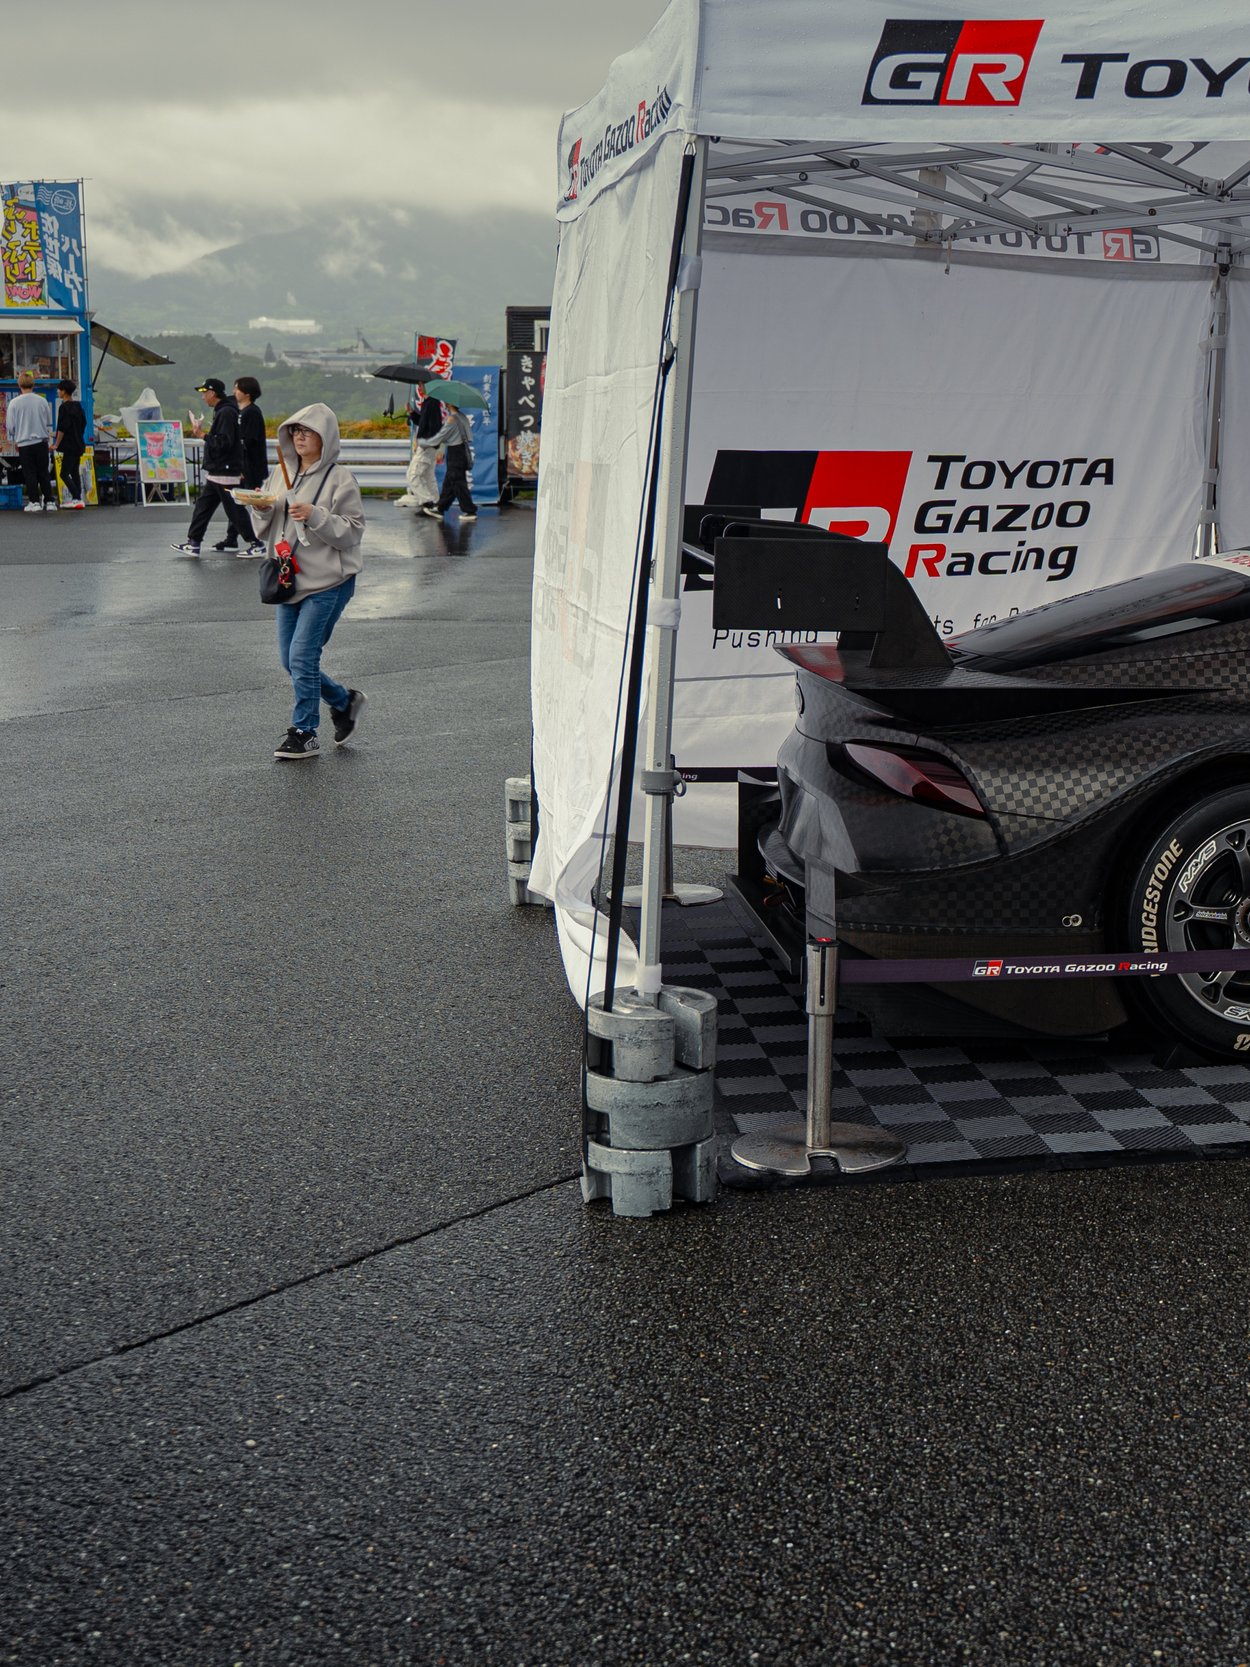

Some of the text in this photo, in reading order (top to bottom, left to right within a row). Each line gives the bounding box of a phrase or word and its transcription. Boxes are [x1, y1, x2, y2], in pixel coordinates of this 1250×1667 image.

[869, 52, 1025, 102] GR
[603, 115, 636, 162] GAZOO
[926, 455, 1114, 490] TOYOTA
[914, 500, 1091, 534] GAZOO
[904, 540, 1078, 581] Racing
[1178, 839, 1217, 893] RAYS
[1141, 838, 1184, 954] RIDGESTONE
[1004, 965, 1060, 974] TOYOTA
[1064, 963, 1116, 972] GAZOO
[1118, 961, 1168, 971] Racing
